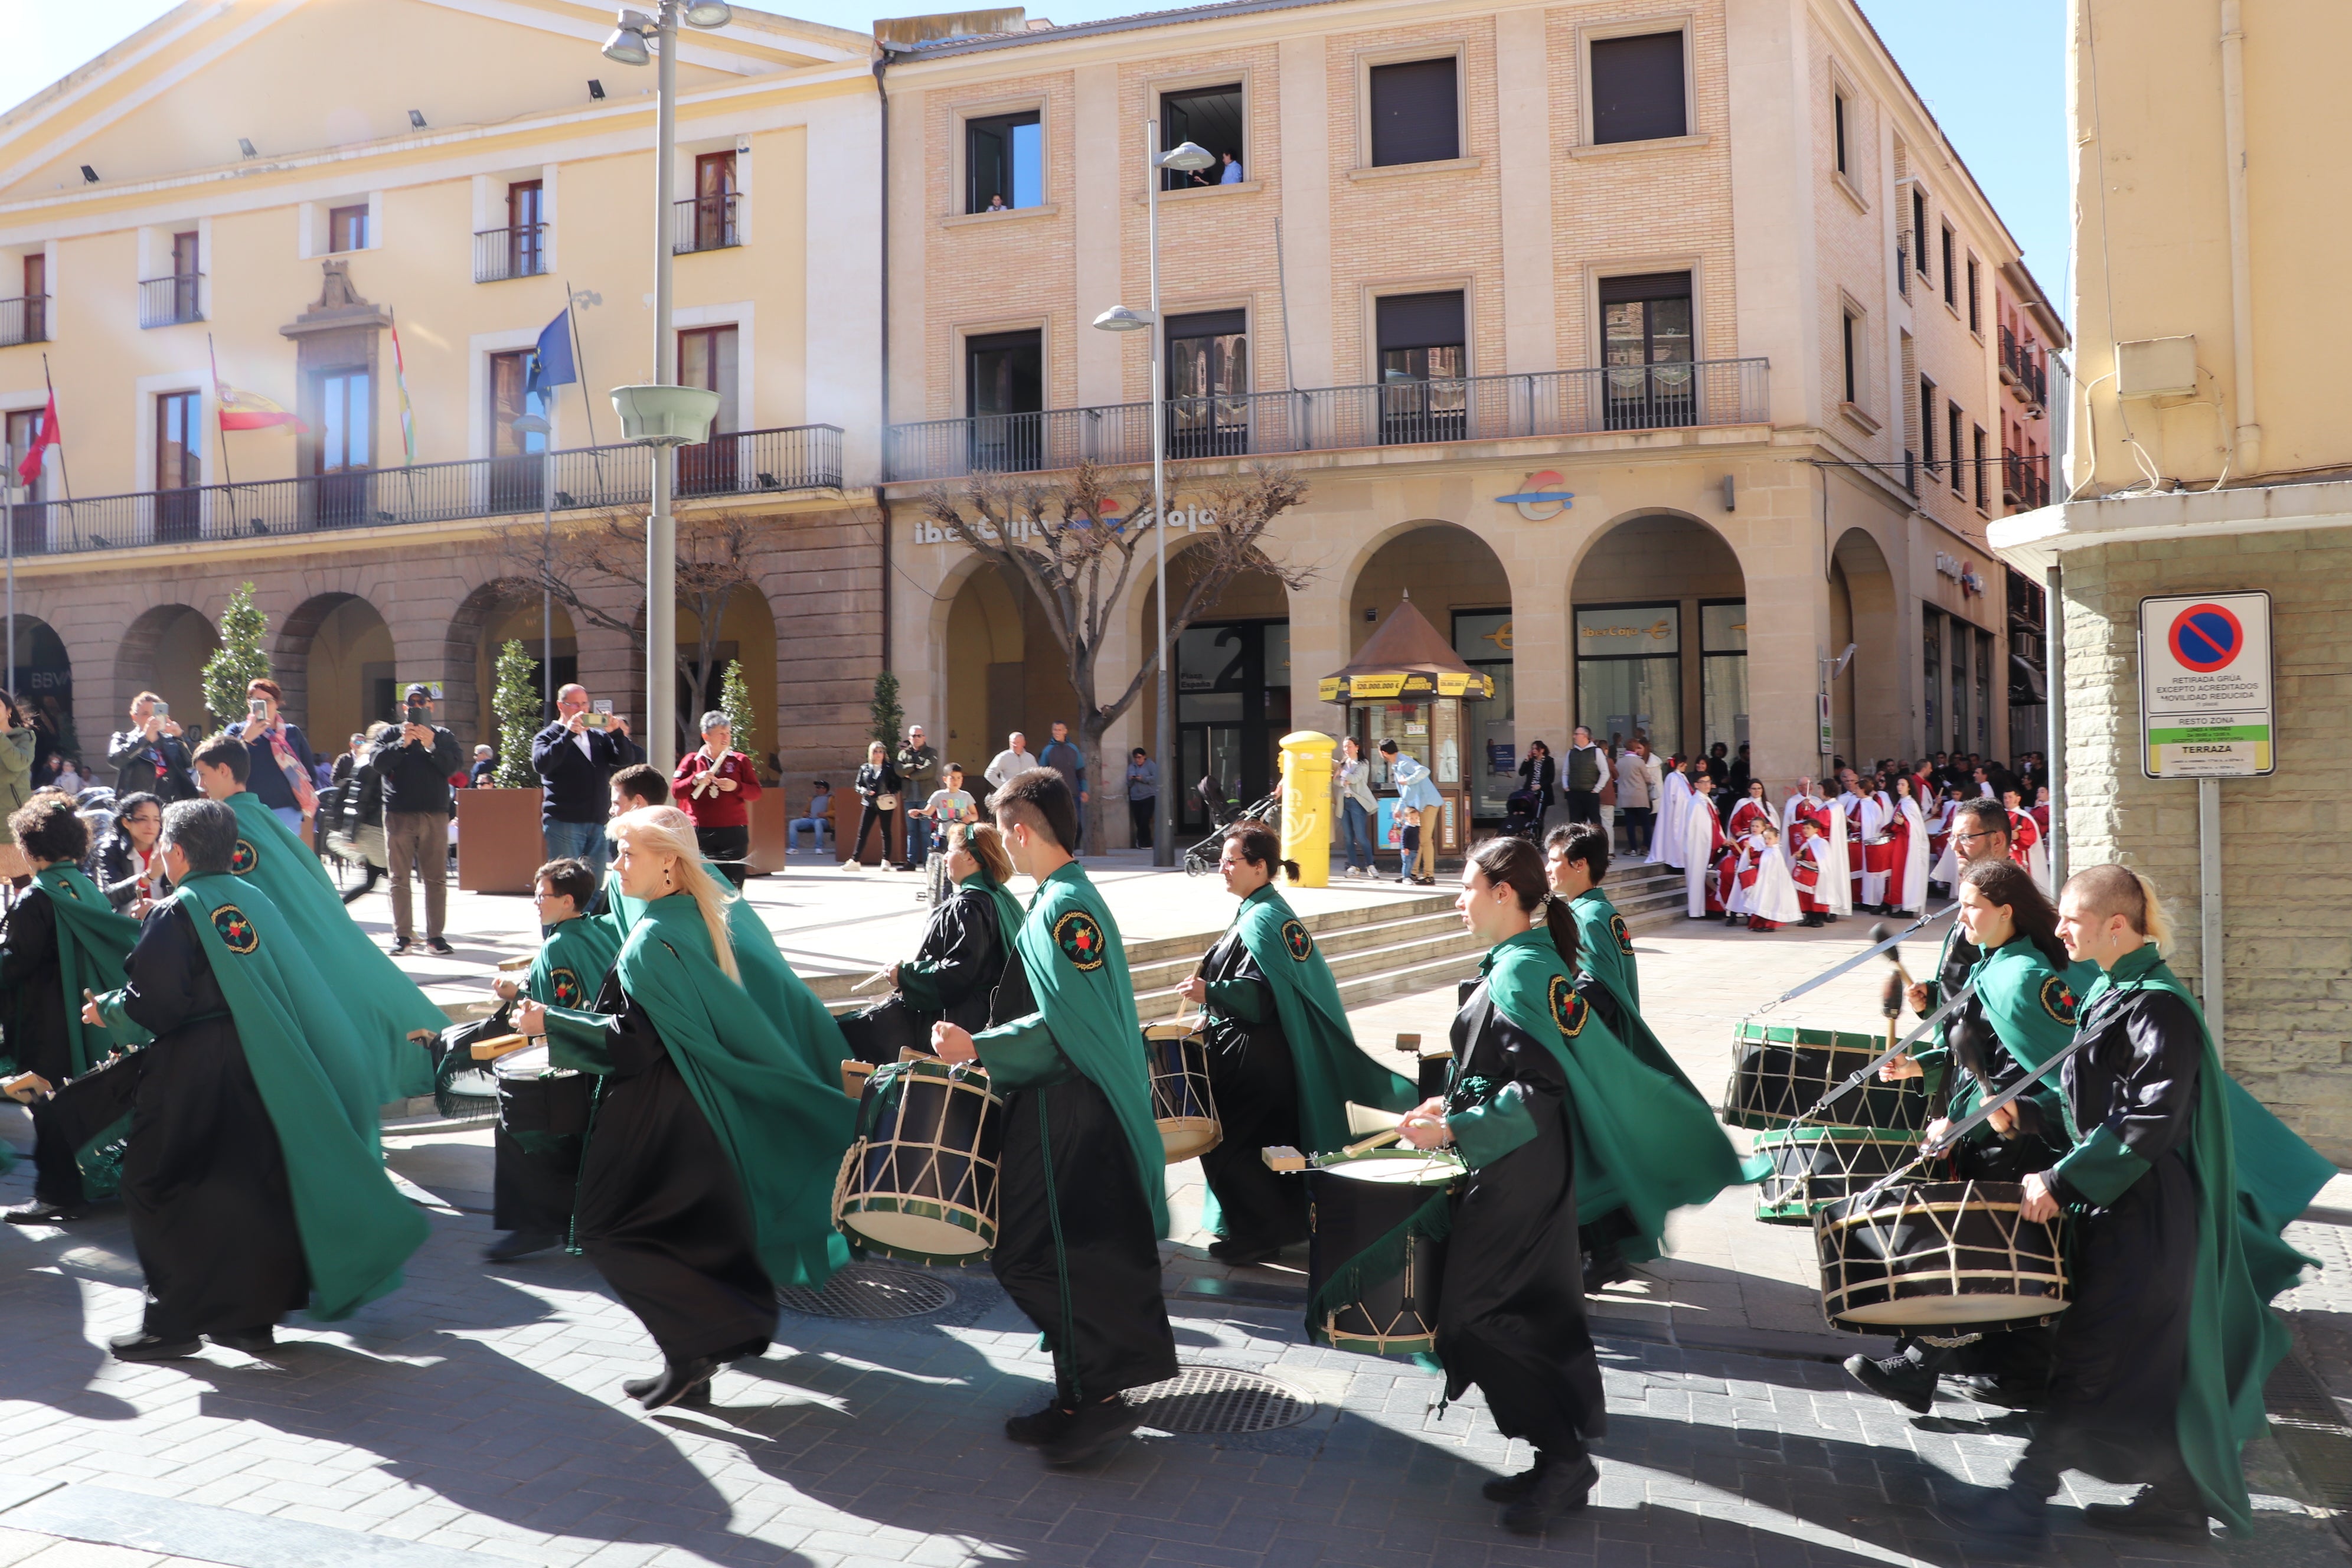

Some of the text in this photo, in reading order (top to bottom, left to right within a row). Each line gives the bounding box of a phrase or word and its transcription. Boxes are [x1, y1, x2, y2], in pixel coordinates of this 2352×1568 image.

[1582, 625, 1639, 639] iberCaja
[1214, 626, 1243, 690] 2
[2198, 683, 2259, 691] ACREDITADOS
[1445, 801, 1453, 843] BIEN JUGADO
